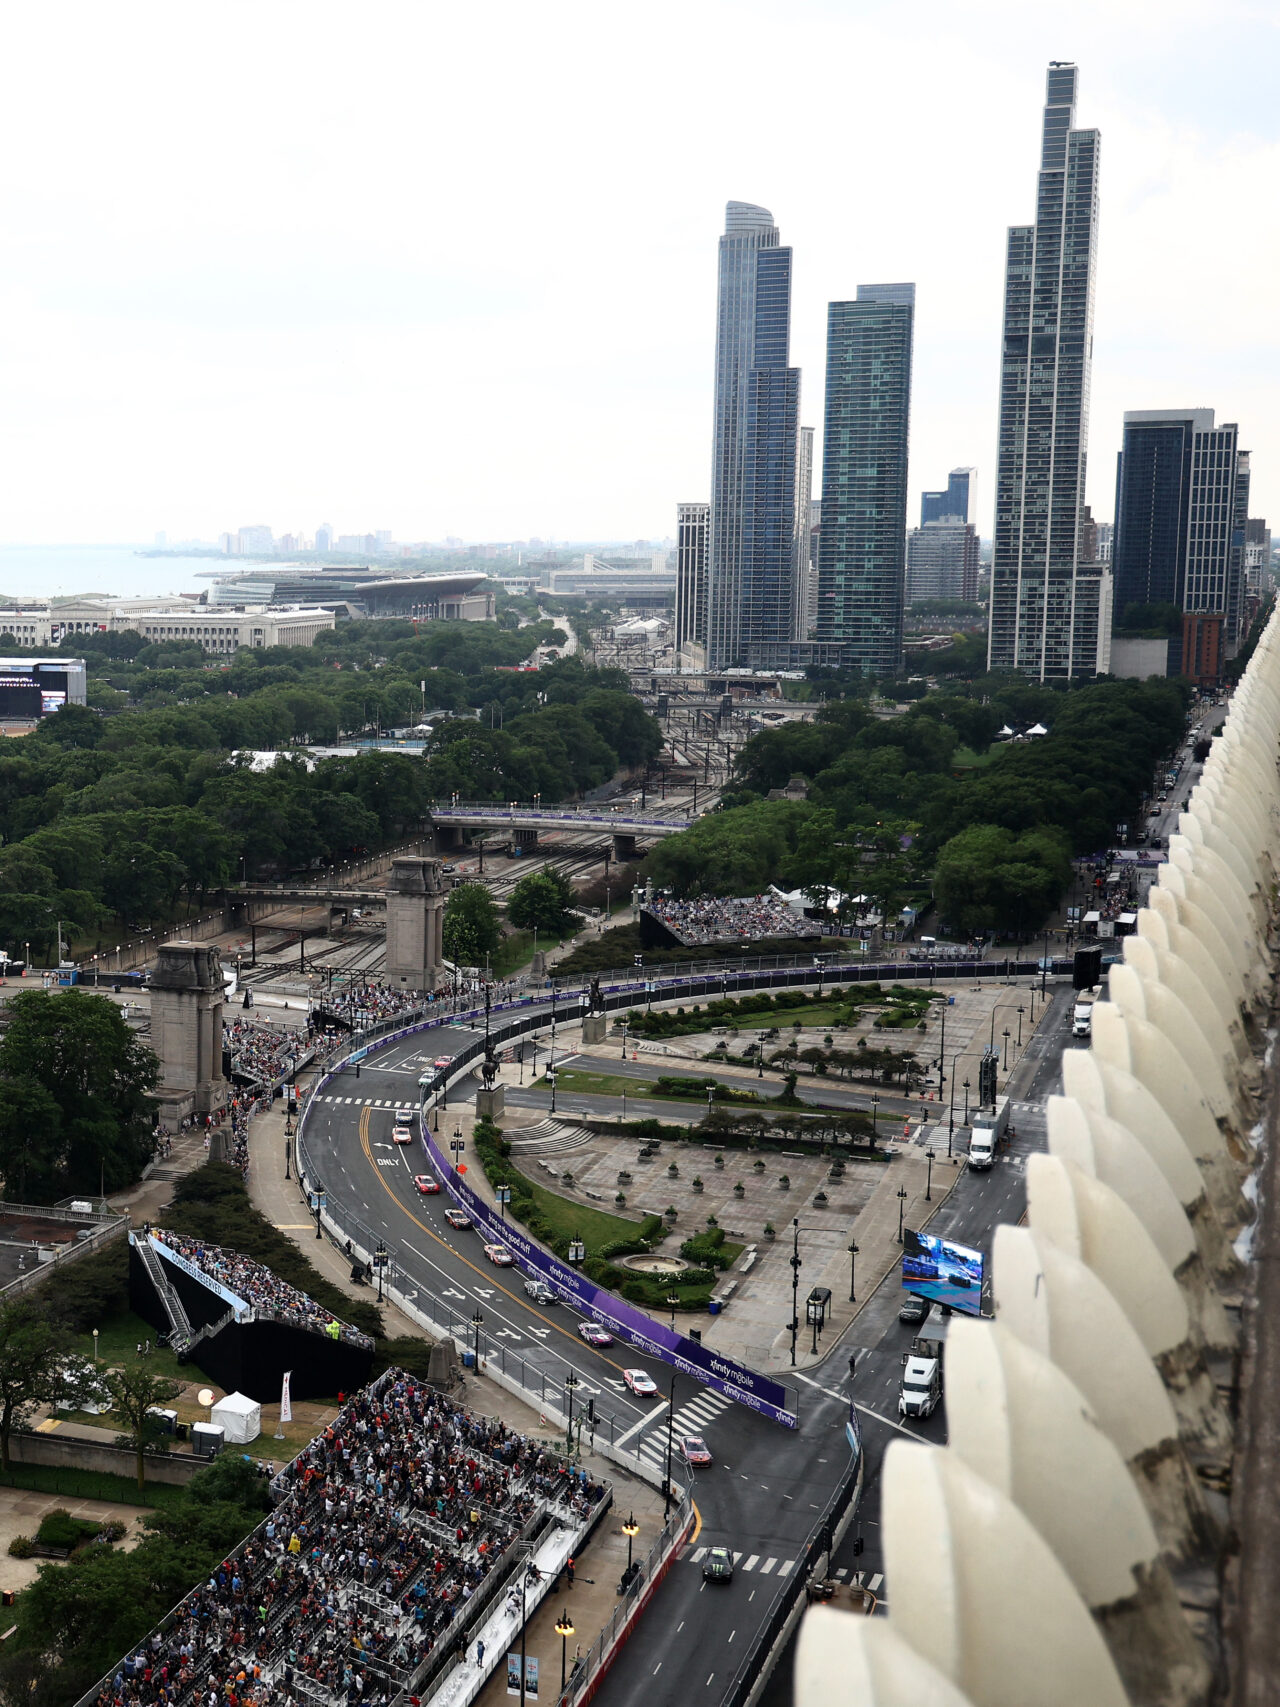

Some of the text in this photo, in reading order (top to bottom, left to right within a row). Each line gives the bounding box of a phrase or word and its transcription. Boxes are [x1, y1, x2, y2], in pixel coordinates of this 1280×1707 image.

[376, 1158, 399, 1166] ONLY
[488, 1212, 498, 1230] bring
[508, 1233, 520, 1246] good
[520, 1240, 531, 1254] stuff
[171, 1253, 222, 1295] CONGRESS RESERVED
[549, 1264, 580, 1290] xfinity mobile
[557, 1287, 570, 1301] xfinity
[591, 1309, 620, 1331] xfinity mobile
[630, 1333, 662, 1356] xfinity mobile
[674, 1358, 692, 1375] xfinity
[710, 1359, 755, 1388] xfinity mobile
[723, 1384, 762, 1409] xfinity mobile
[775, 1410, 795, 1427] xfinity
